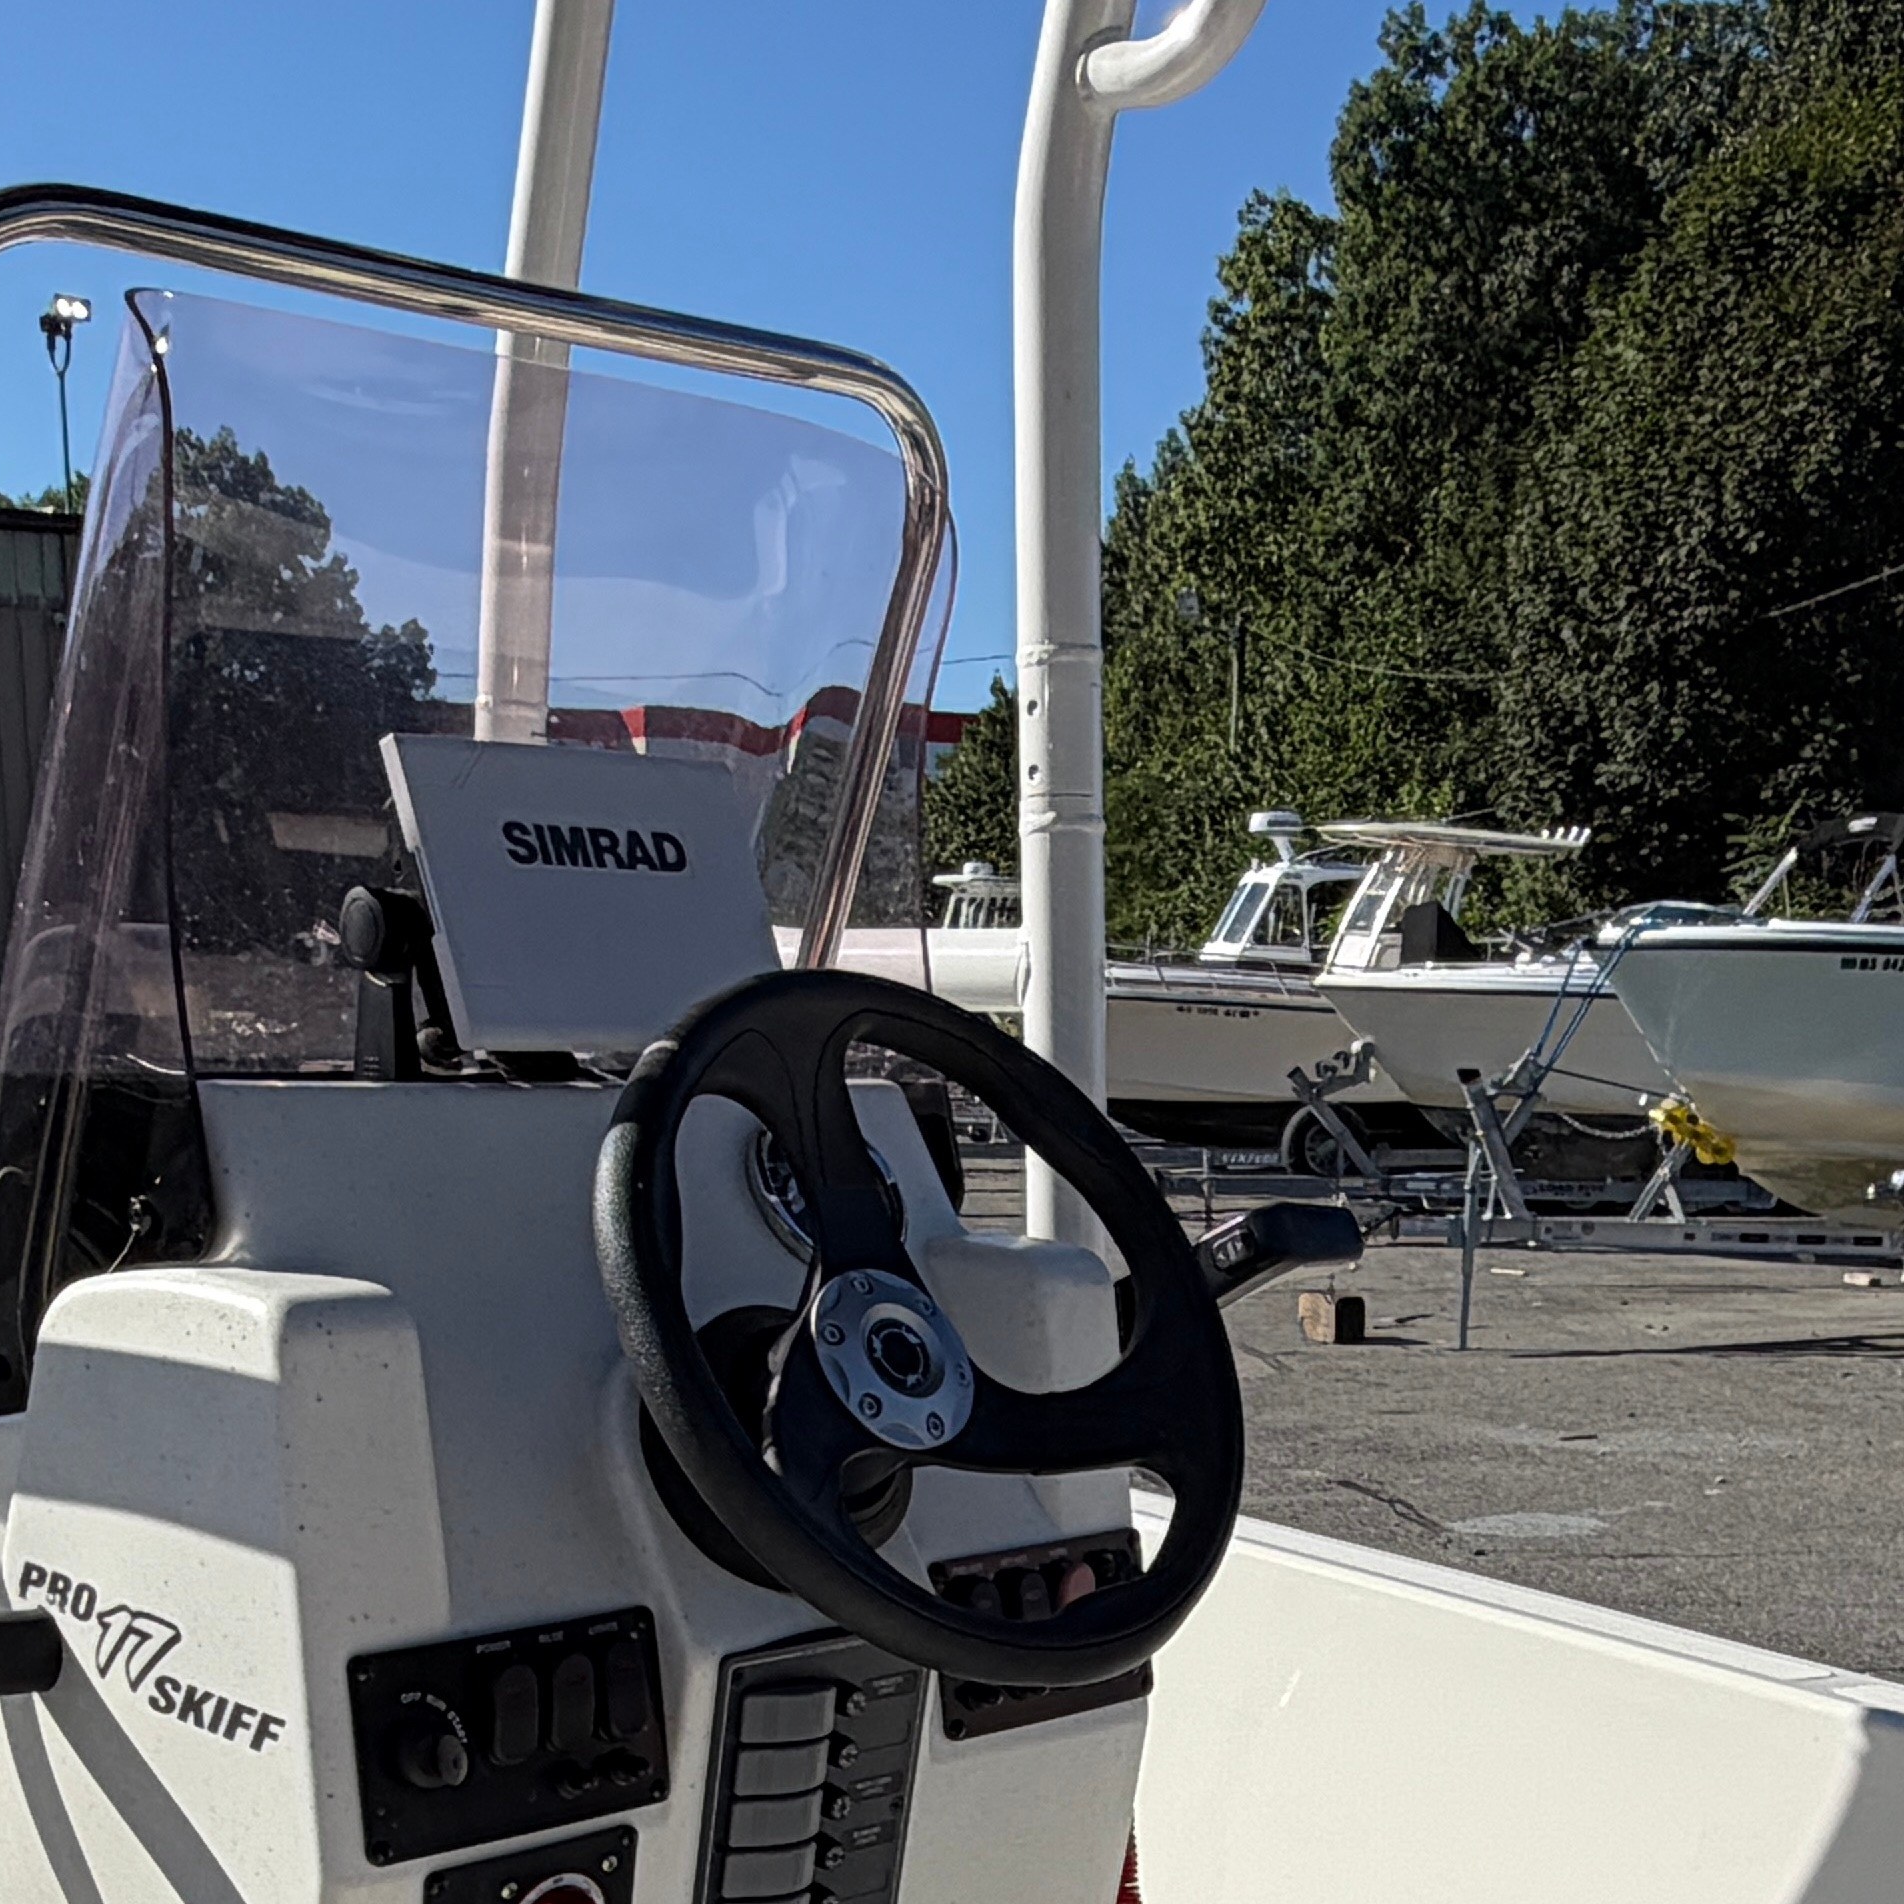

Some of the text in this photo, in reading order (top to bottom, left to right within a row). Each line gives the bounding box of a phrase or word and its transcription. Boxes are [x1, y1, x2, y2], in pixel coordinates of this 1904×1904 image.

[501, 820, 688, 873] SIMRAD
[18, 1561, 286, 1752] PRO 17 SKIFF
